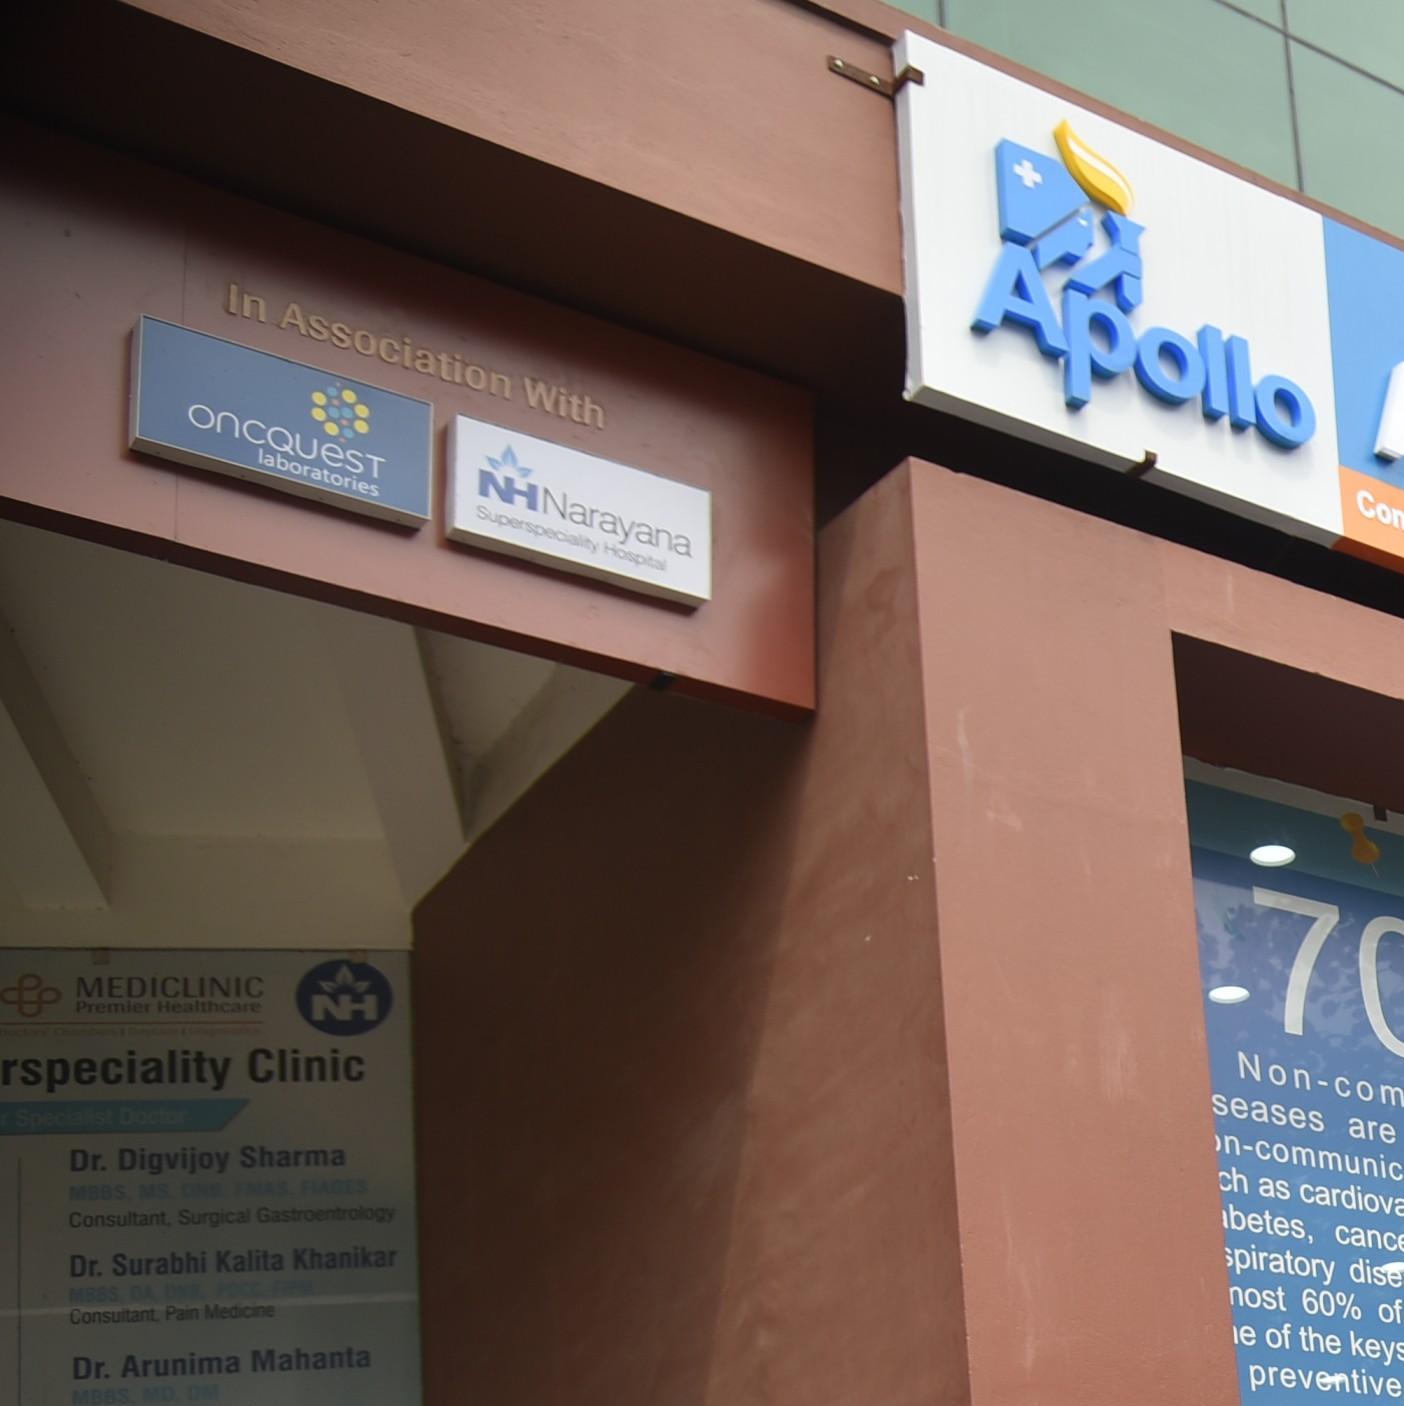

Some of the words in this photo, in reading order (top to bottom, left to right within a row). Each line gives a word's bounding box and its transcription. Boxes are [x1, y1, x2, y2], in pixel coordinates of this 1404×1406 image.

[225, 283, 267, 323] In
[279, 301, 513, 400] Association
[524, 378, 605, 430] With
[970, 242, 1318, 449] Apollo
[258, 448, 379, 497] laboratories
[478, 469, 540, 512] NH
[476, 505, 599, 556] Superspeciality
[603, 540, 668, 573] Hospital
[543, 488, 694, 558] Narayana
[76, 975, 264, 999] MEDICLINIC
[76, 1001, 151, 1015] Premier
[158, 1000, 262, 1014] Healthcare
[312, 995, 382, 1021] NH
[248, 1048, 366, 1084] Clinic
[1212, 1093, 1325, 1132] seases
[1348, 1116, 1397, 1143] are
[70, 1149, 107, 1172] Dr.
[118, 1146, 230, 1175] Digvijoy
[240, 1145, 346, 1168] Sharma
[70, 1254, 103, 1277] Dr.
[112, 1251, 207, 1276] Surabhi
[216, 1249, 284, 1274] Kalita
[293, 1246, 397, 1272] Khanikar
[72, 1357, 111, 1380] Dr.
[121, 1352, 241, 1378] Arunima
[251, 1347, 372, 1373] Mahanta
